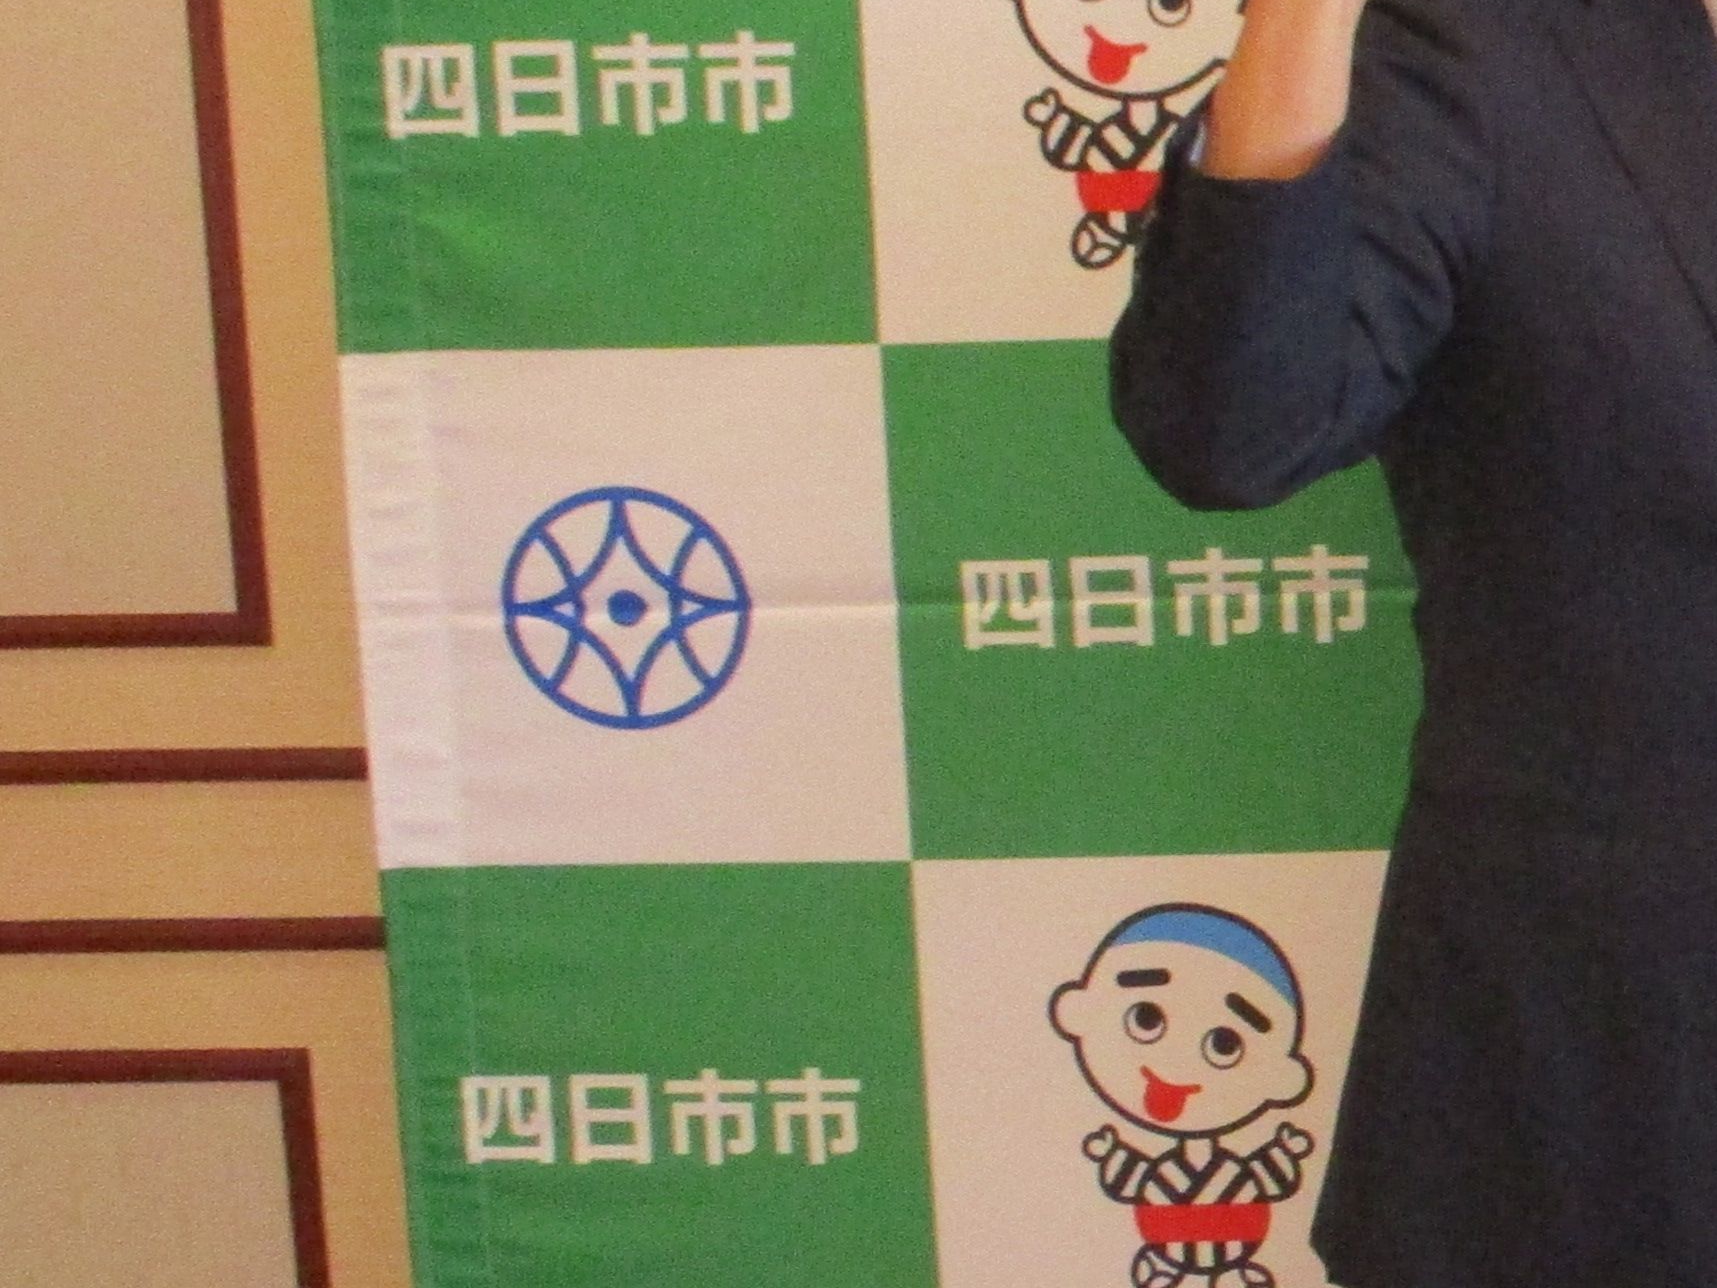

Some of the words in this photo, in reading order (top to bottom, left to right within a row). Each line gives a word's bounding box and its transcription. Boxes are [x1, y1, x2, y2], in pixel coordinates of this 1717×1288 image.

[380, 30, 795, 139] 四日市市
[959, 544, 1368, 650] 四日市市
[460, 1068, 860, 1165] 四日市市
